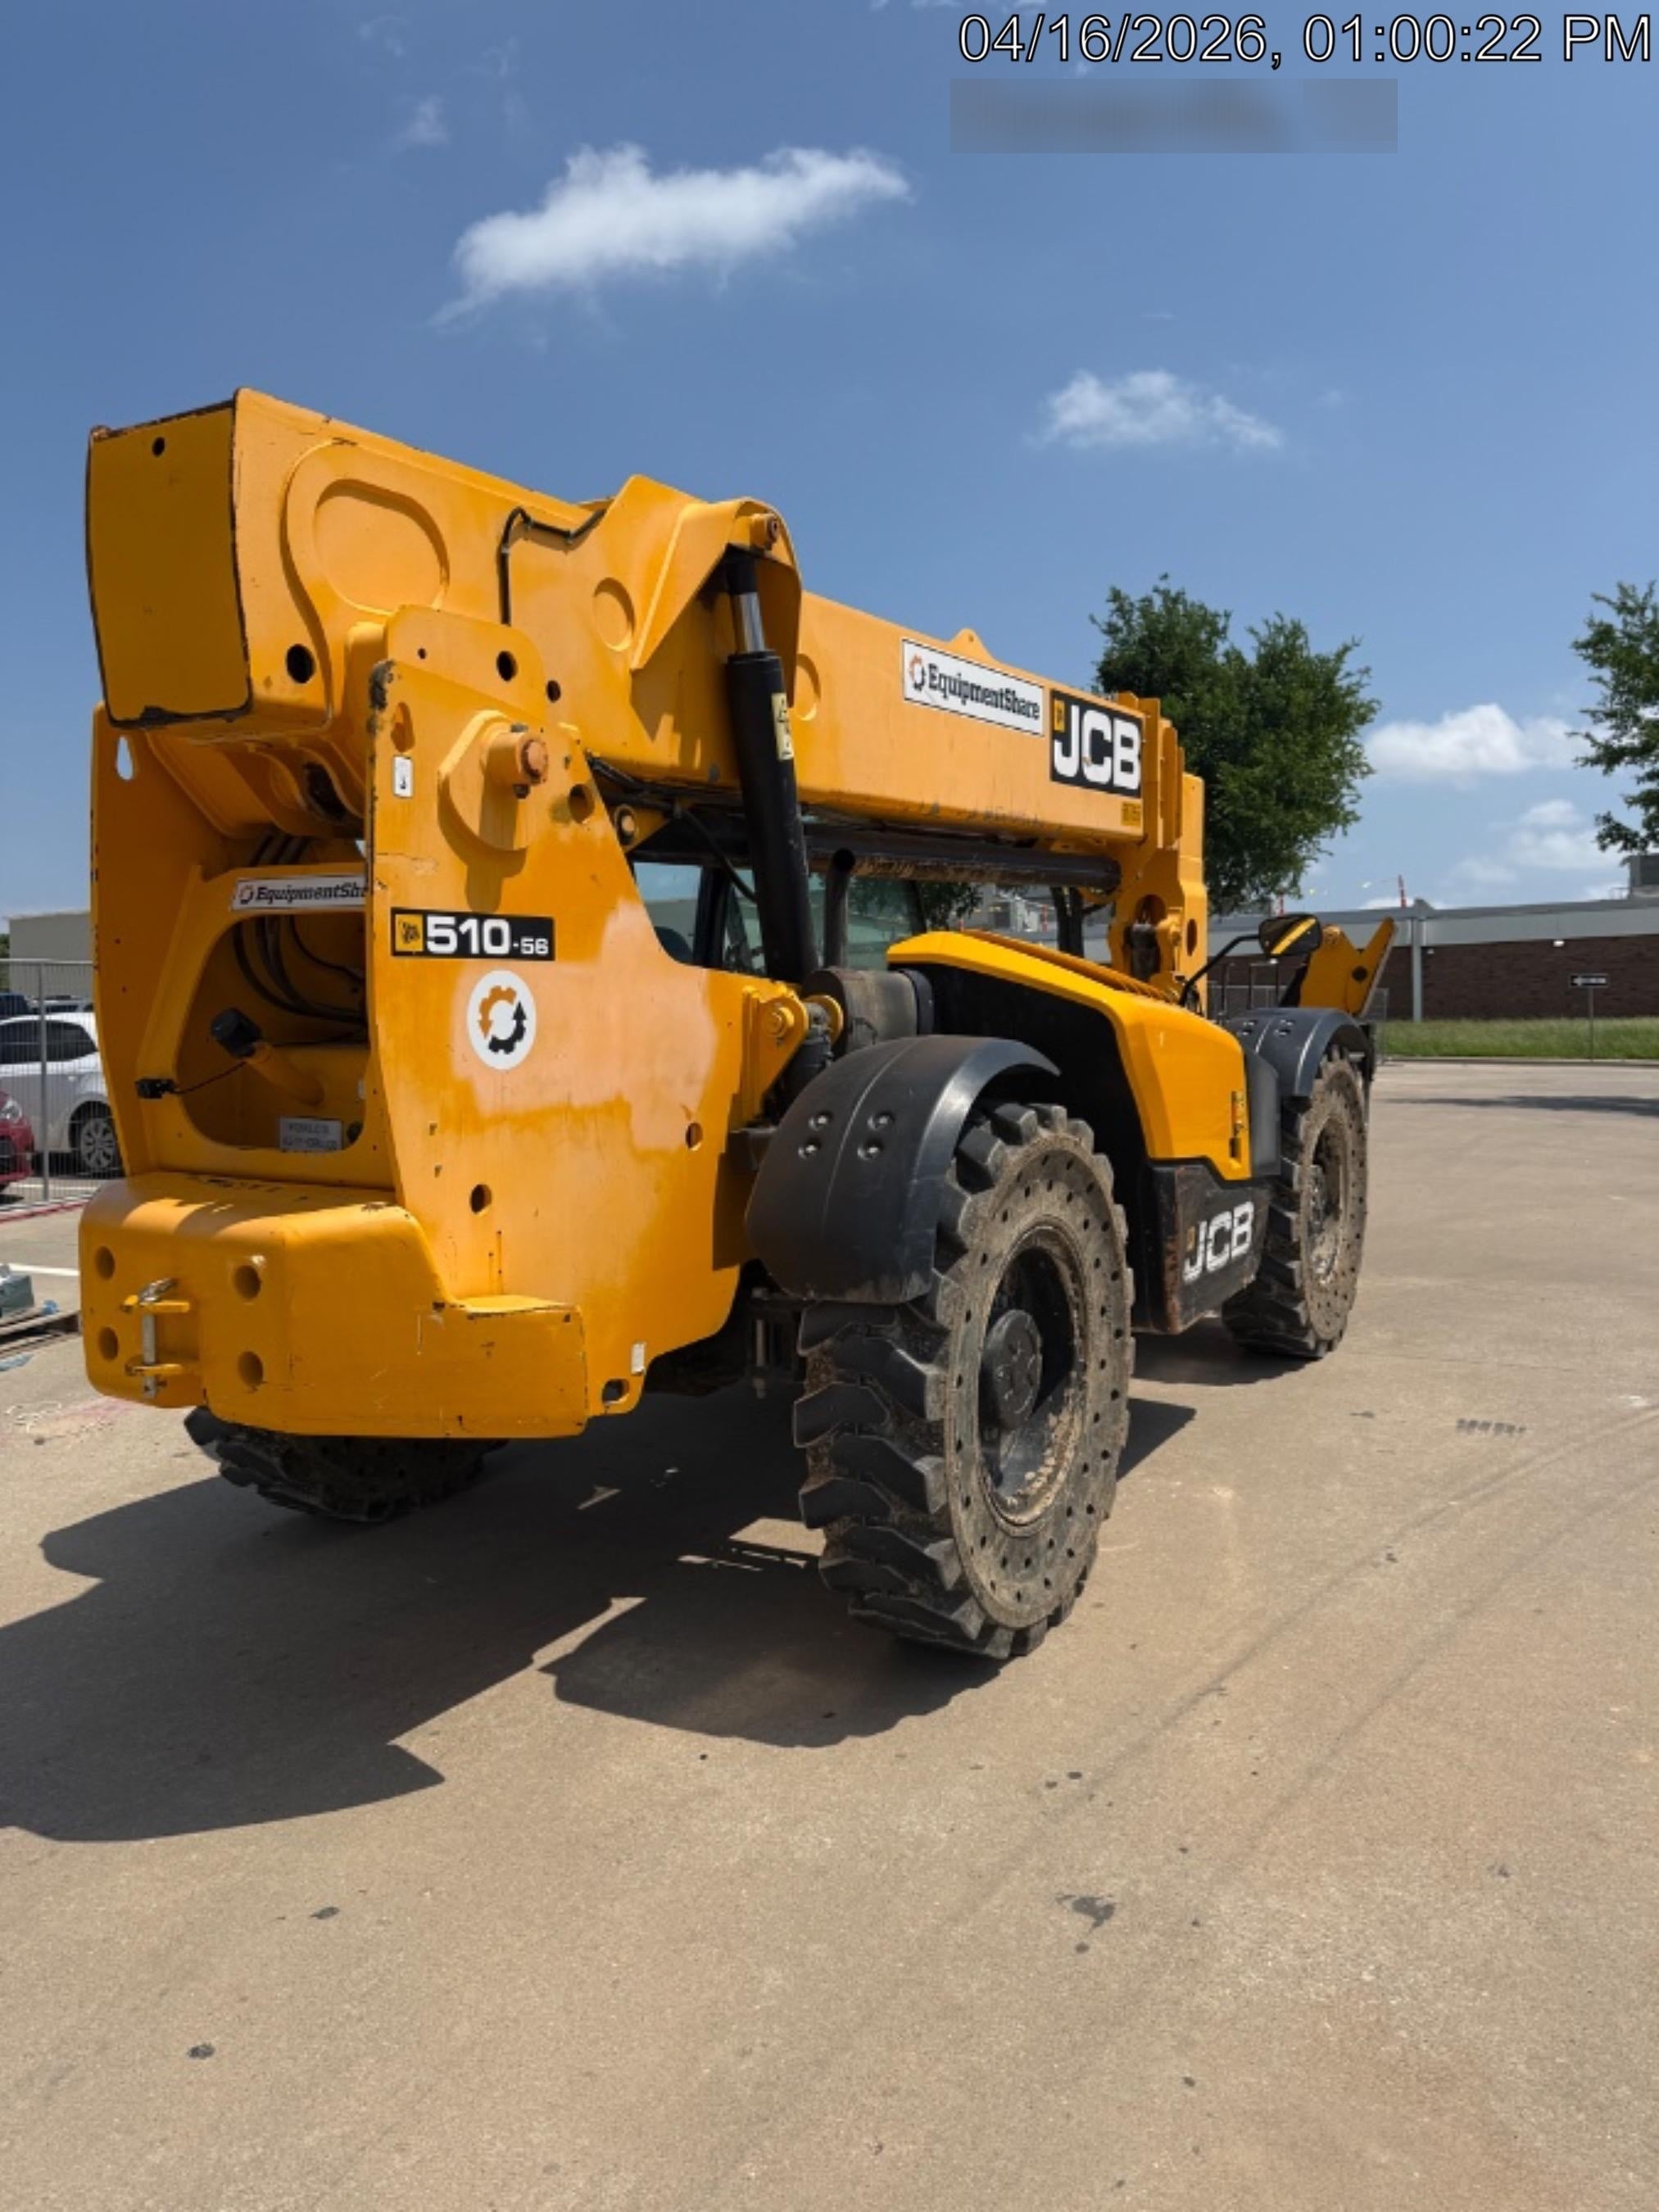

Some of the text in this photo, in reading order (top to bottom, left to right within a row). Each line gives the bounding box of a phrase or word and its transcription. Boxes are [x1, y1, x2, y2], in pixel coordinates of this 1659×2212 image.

[927, 663, 1040, 720] EquipmentShare
[1054, 704, 1140, 790] JCB
[1182, 1201, 1254, 1284] JCB
